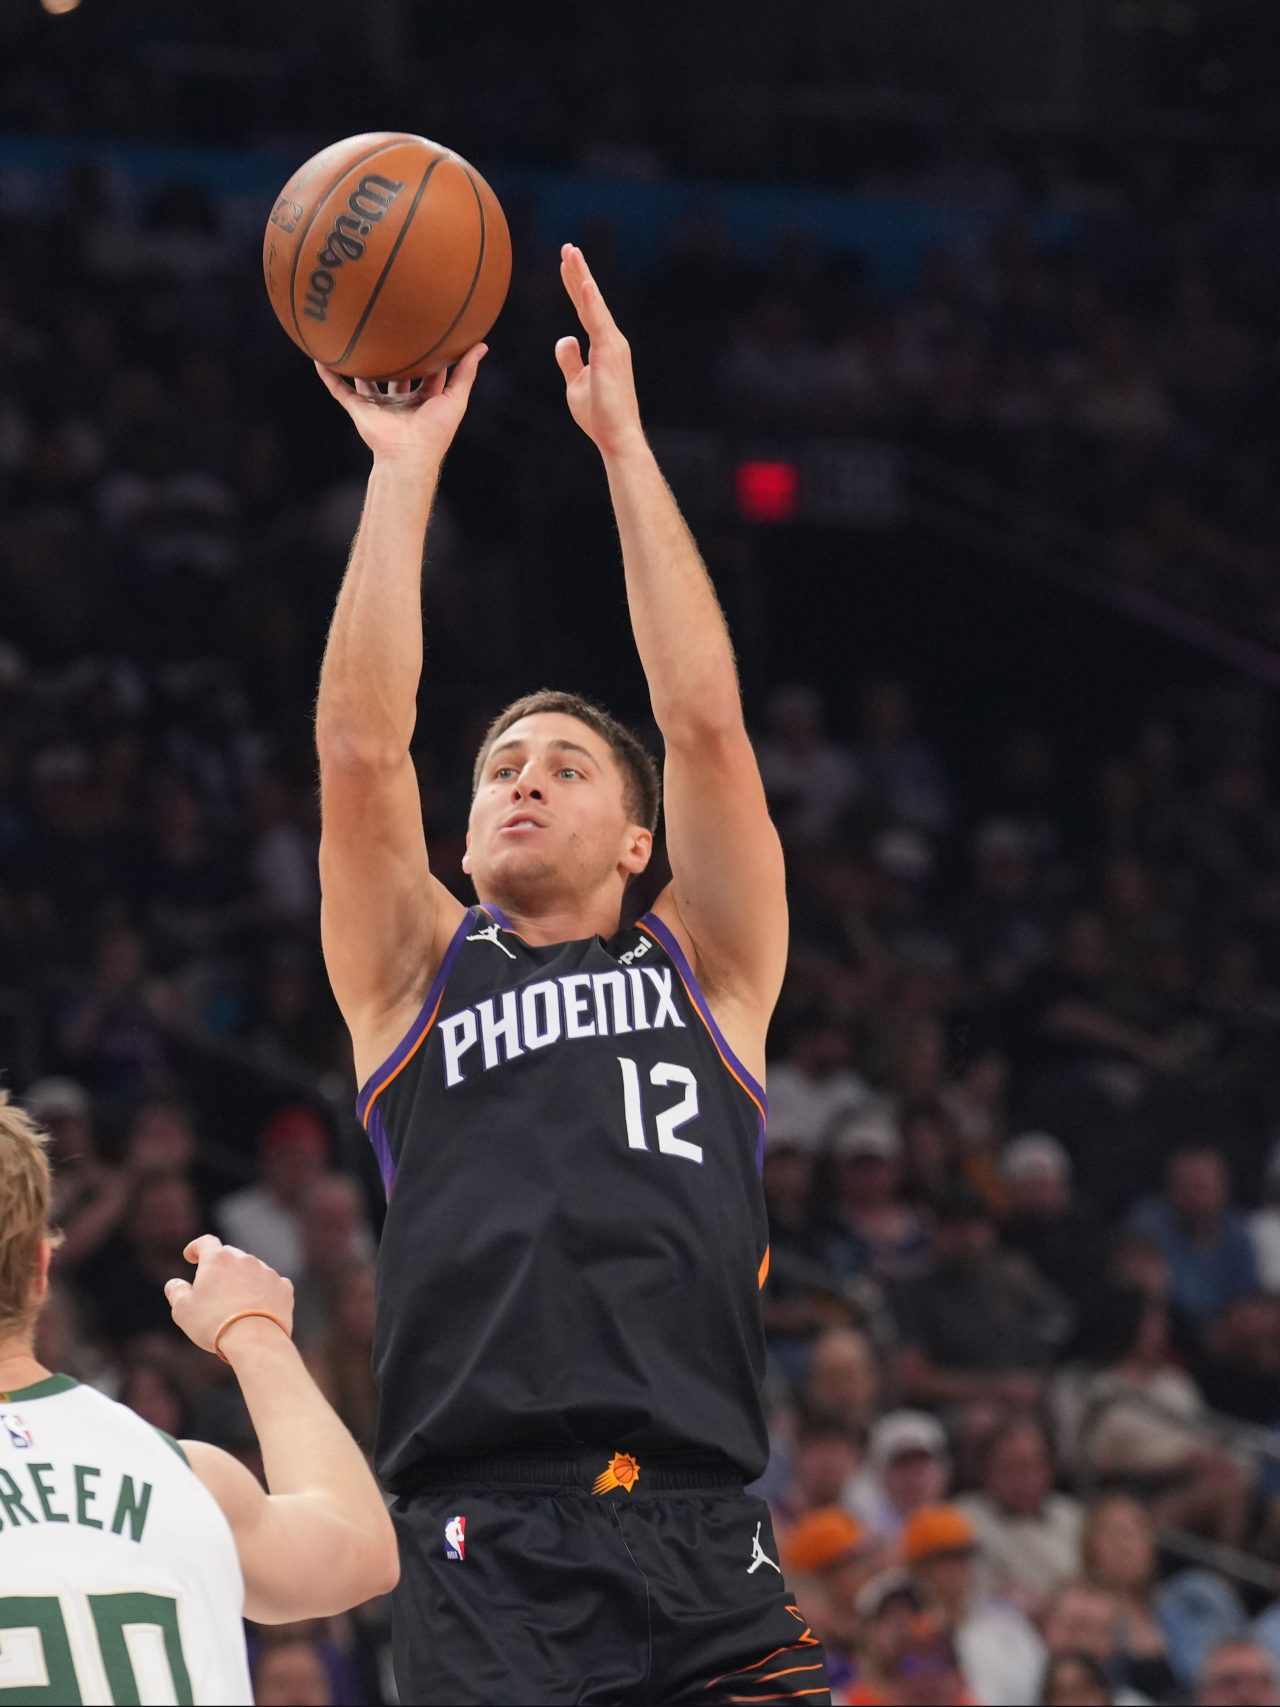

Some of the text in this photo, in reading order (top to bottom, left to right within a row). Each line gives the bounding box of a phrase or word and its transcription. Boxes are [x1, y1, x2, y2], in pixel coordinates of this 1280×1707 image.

[303, 173, 405, 322] Wilson
[618, 935, 653, 965] Pal
[437, 966, 687, 1089] PHOENIX
[616, 1056, 704, 1165] 12
